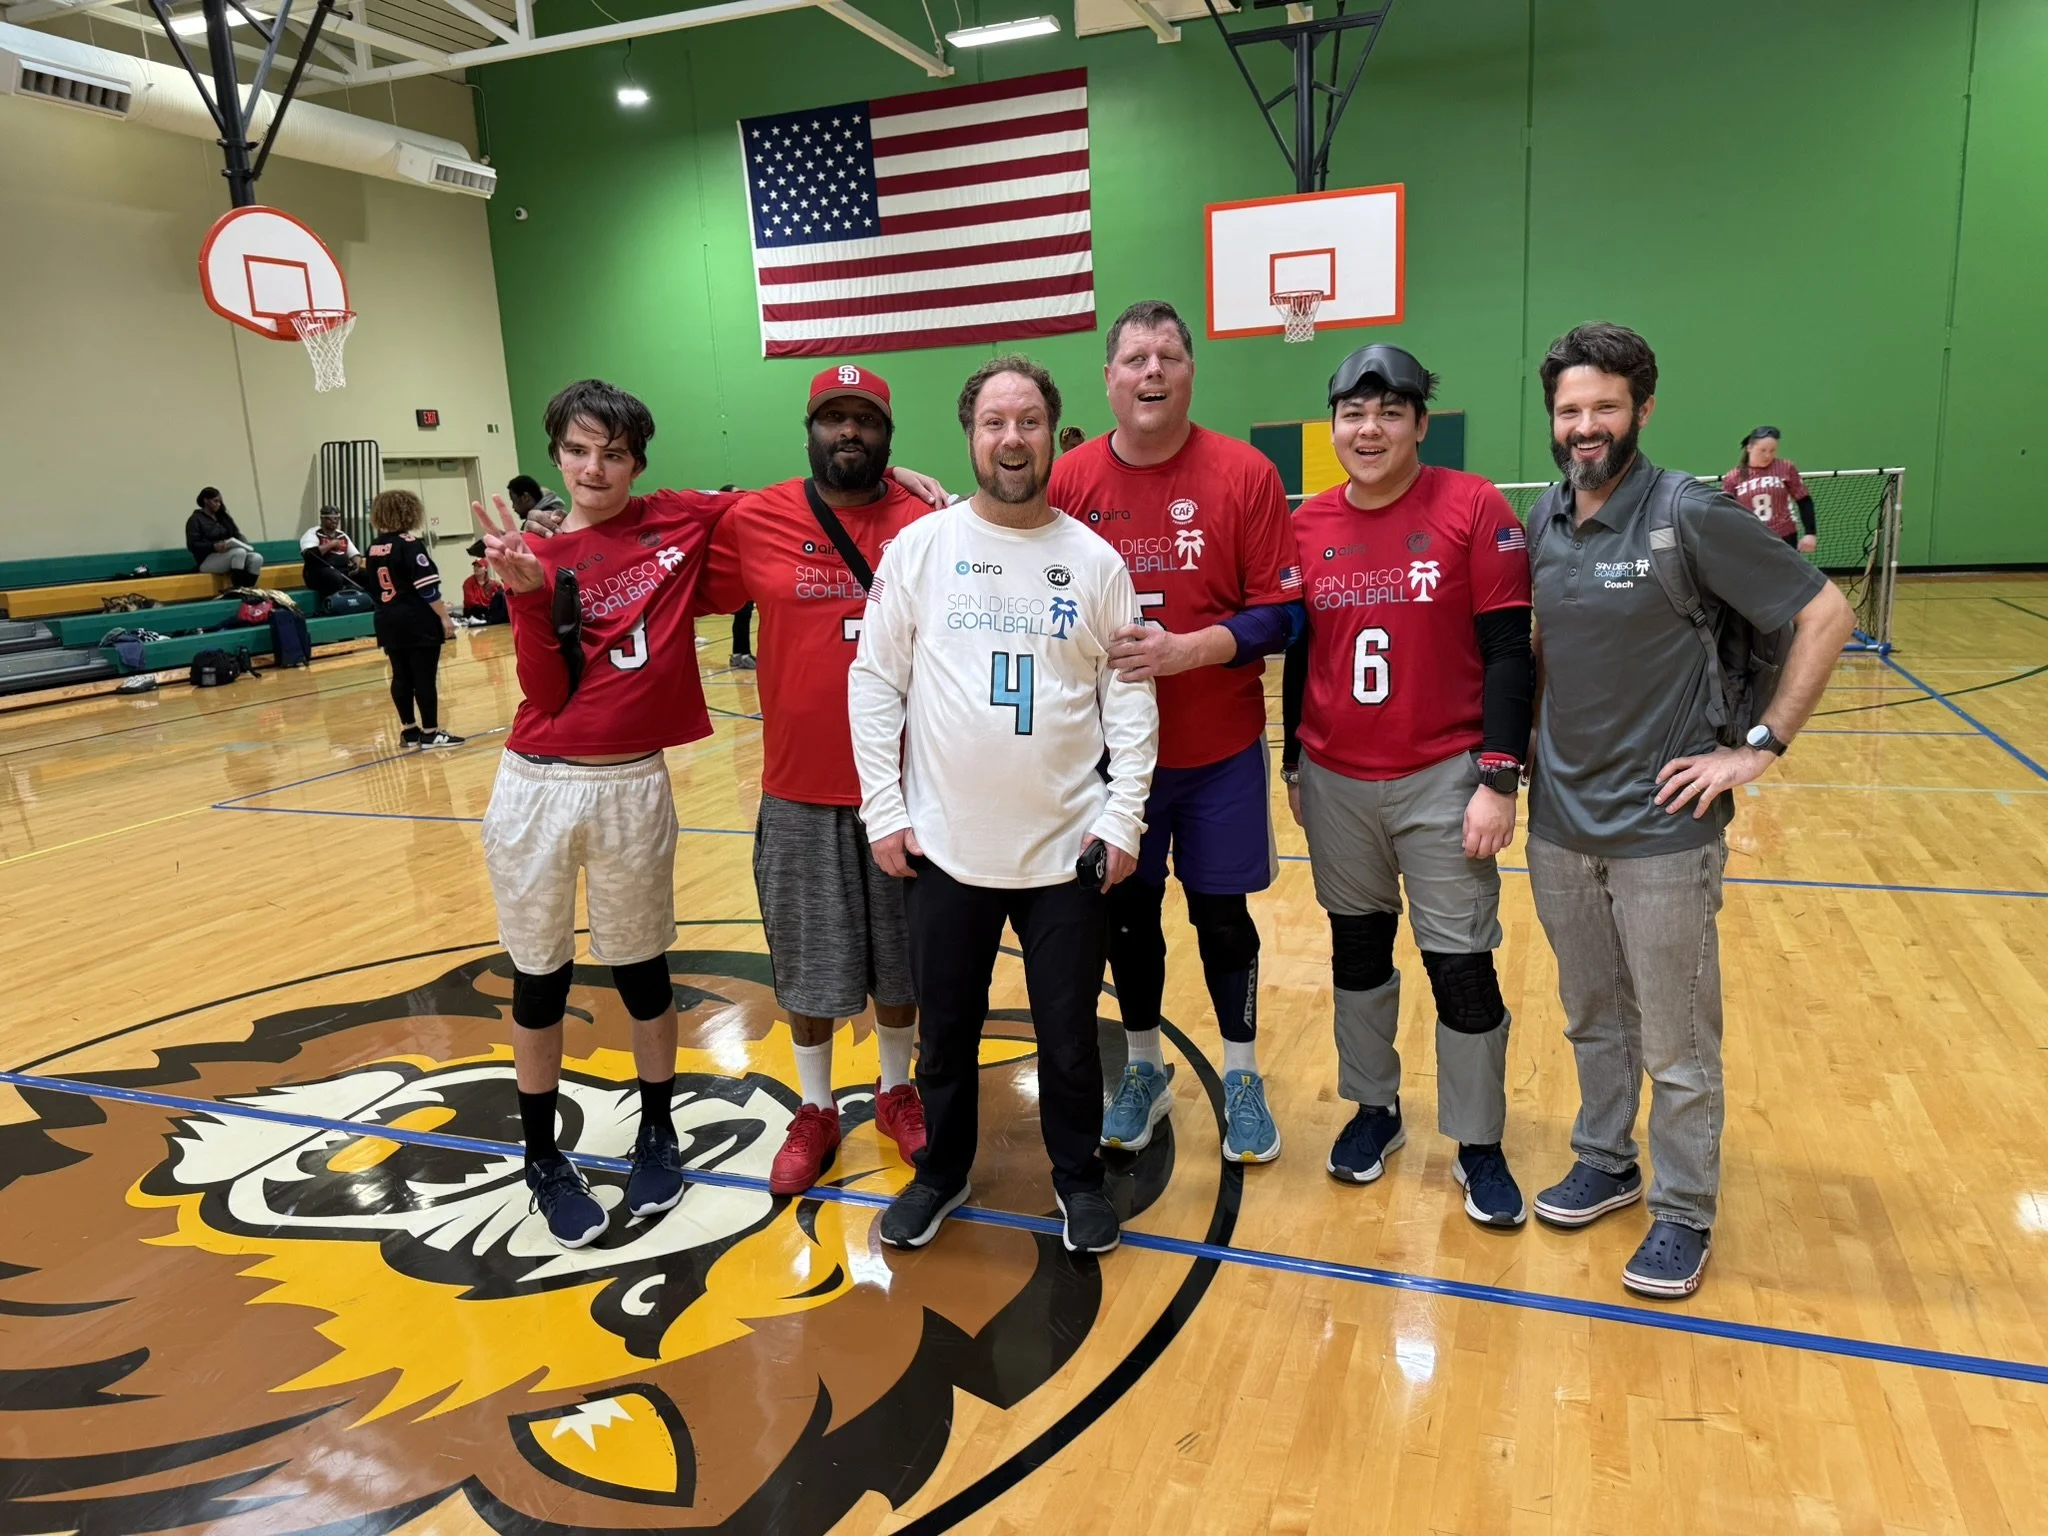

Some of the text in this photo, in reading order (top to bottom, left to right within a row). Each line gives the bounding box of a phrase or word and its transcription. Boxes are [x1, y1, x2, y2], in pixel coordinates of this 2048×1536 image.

[838, 365, 859, 385] SD
[1173, 507, 1193, 516] CAF
[1752, 494, 1773, 521] 8
[817, 543, 838, 555] air
[1120, 536, 1172, 555] DIEGO
[972, 562, 1003, 575] aira
[1126, 554, 1178, 573] LBALL
[1595, 561, 1634, 570] SAN DIEGO
[579, 561, 657, 606] AN DIEGO
[795, 565, 830, 583] SAN
[1048, 572, 1069, 583] CAF
[1314, 567, 1404, 594] SAN DIEGO
[1604, 580, 1634, 588] Coach
[377, 566, 397, 603] 9
[795, 582, 868, 599] GOALB
[947, 593, 1045, 616] SAN DIEGO
[1313, 585, 1410, 611] GOALBALL
[947, 612, 1049, 637] GOALBALL
[1352, 626, 1391, 706] 6
[990, 651, 1034, 736] 4
[1243, 957, 1256, 1029] ARMOU
